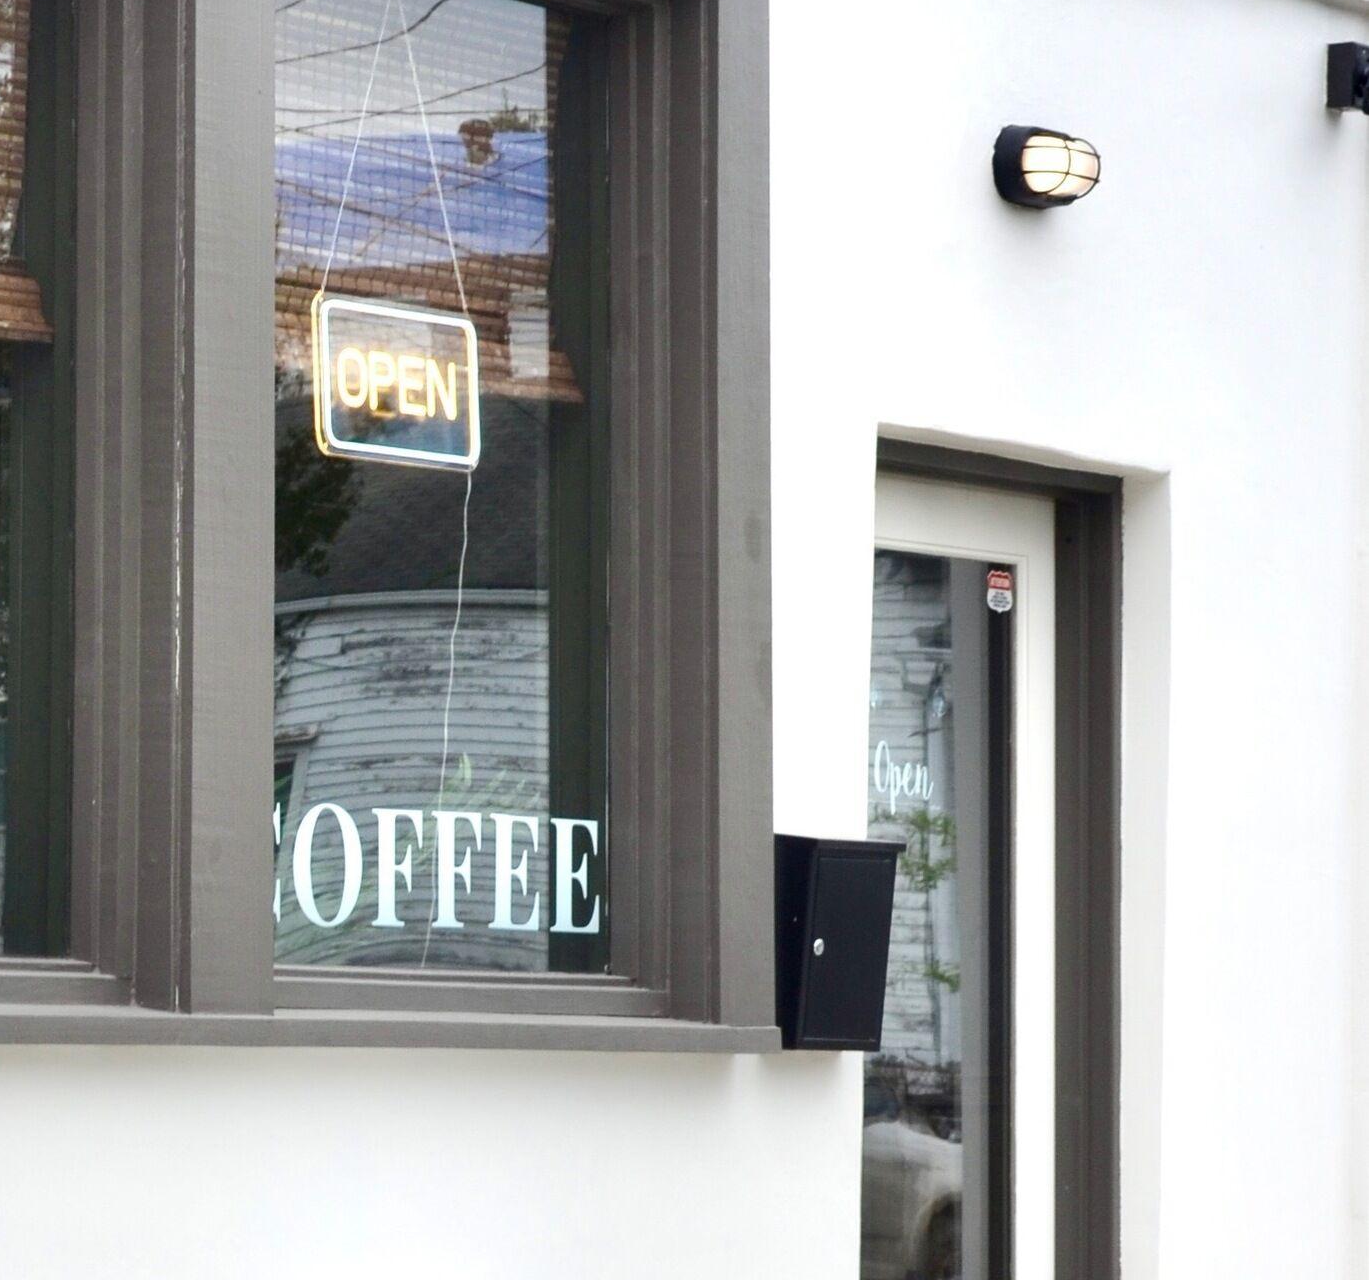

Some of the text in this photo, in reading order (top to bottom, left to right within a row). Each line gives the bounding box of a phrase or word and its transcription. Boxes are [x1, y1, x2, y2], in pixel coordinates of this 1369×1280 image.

[337, 347, 457, 421] OPEN
[874, 740, 934, 815] Open
[273, 801, 600, 934] OFFEE
